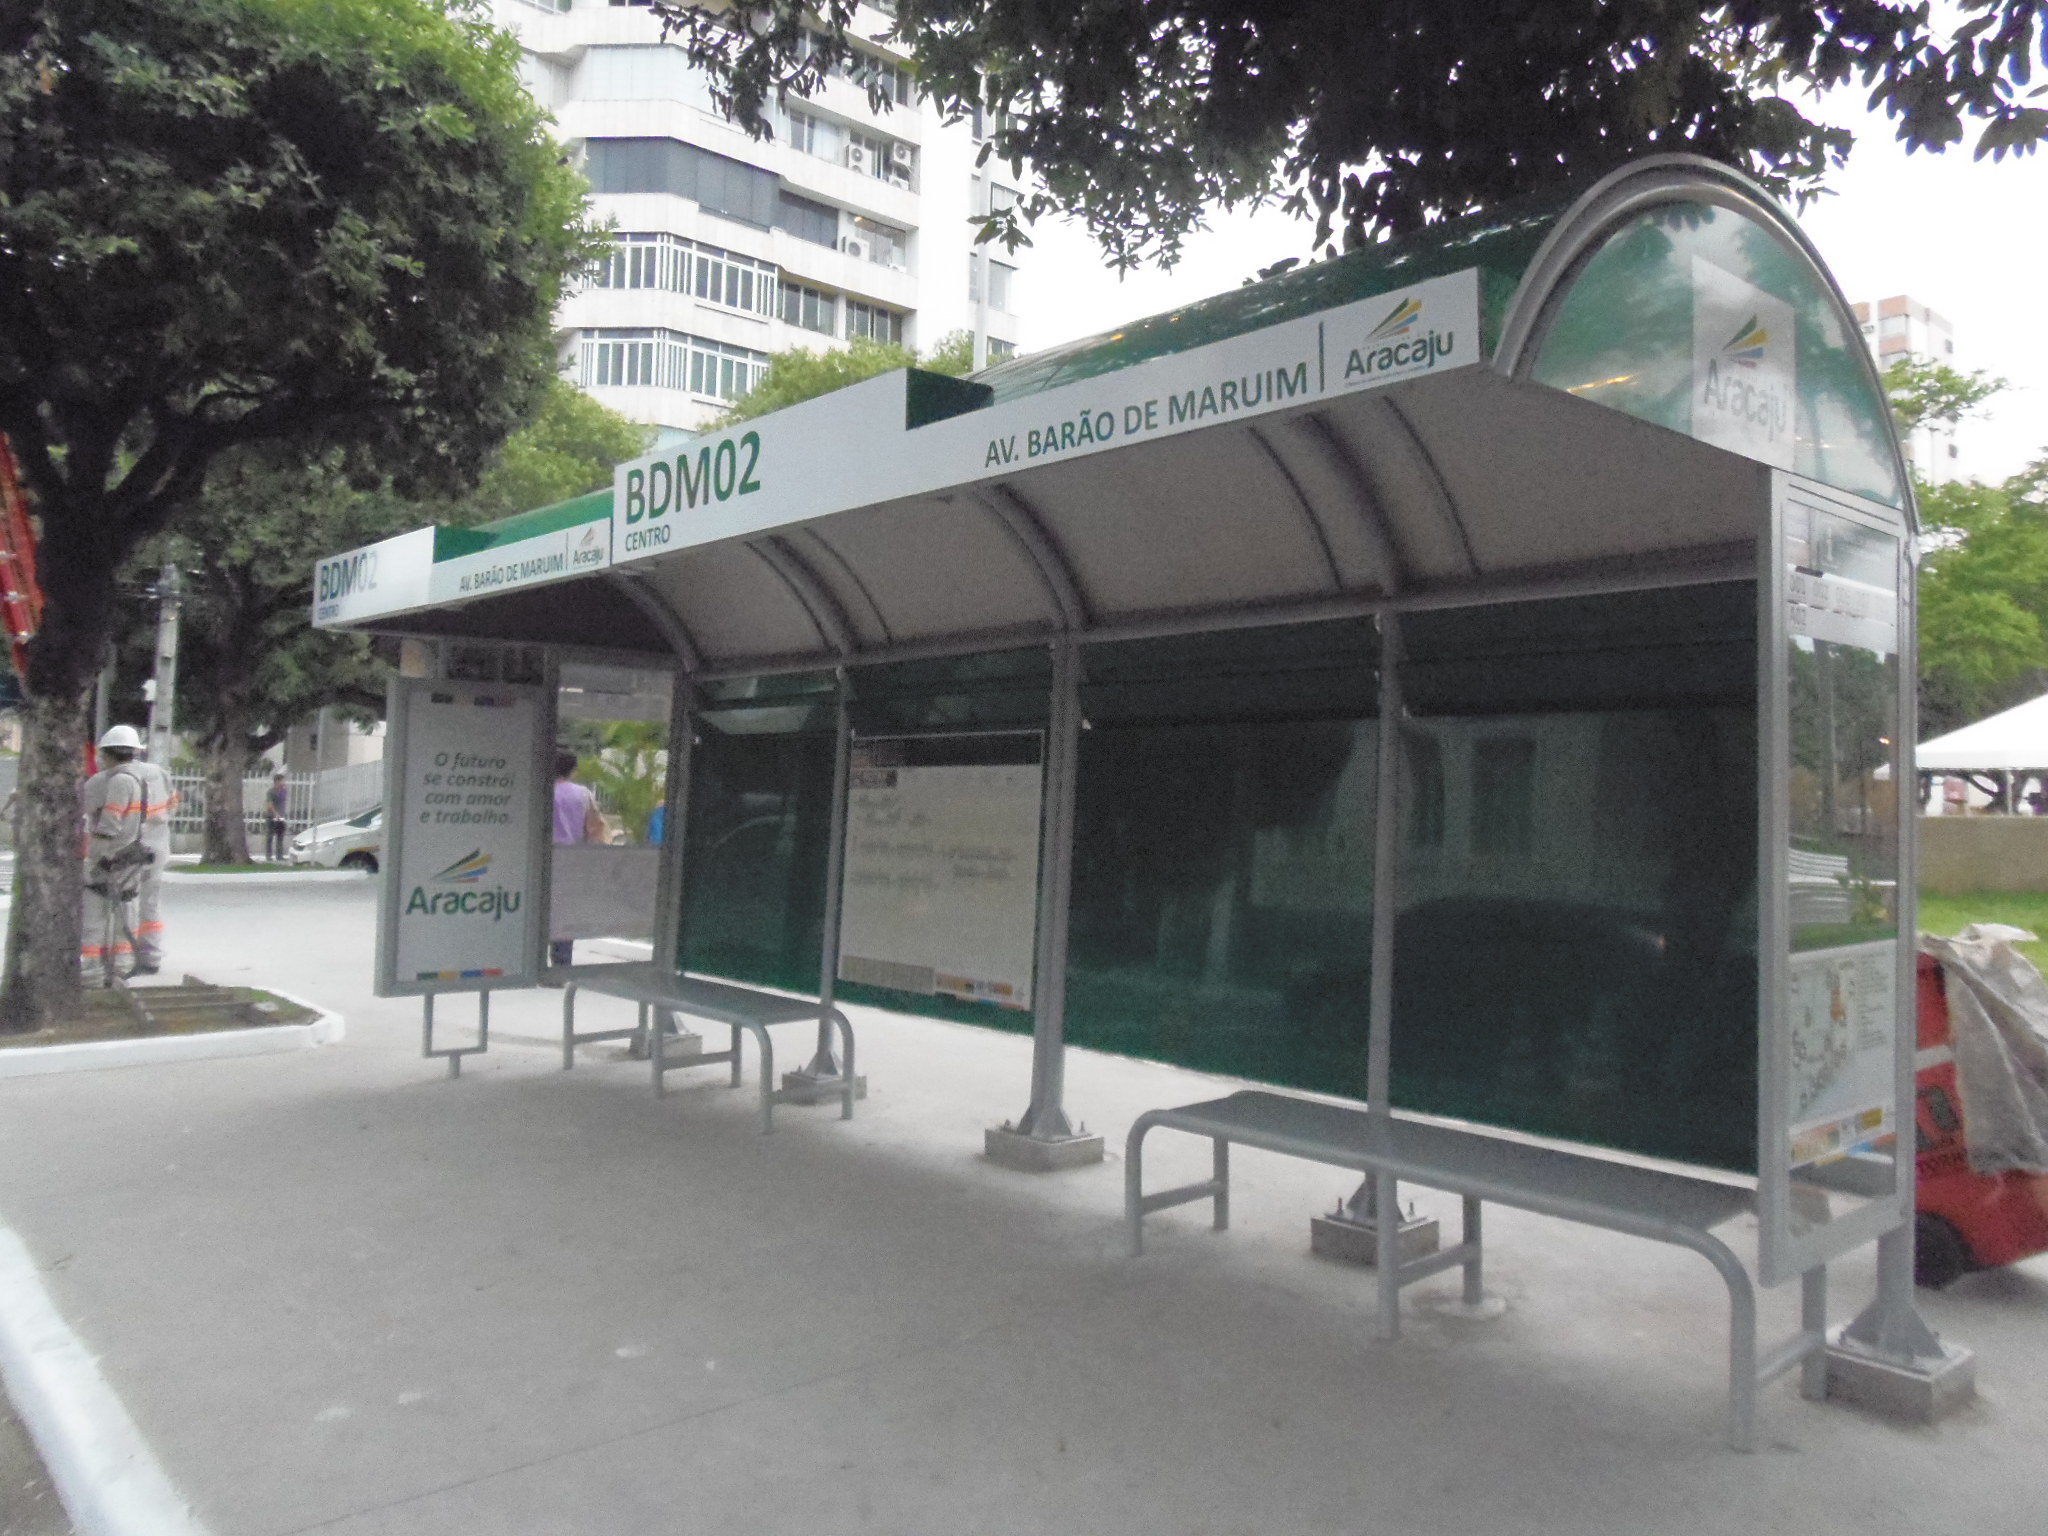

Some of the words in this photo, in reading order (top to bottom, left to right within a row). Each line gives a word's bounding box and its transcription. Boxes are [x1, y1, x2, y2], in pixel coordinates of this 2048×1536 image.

[1343, 329, 1454, 380] Aracaju
[984, 435, 1020, 468] AV.
[1027, 408, 1115, 459] BARÃO
[1123, 399, 1159, 436] DE
[1167, 361, 1308, 427] MARUIM
[1703, 356, 1790, 444] Aracaju
[625, 429, 762, 526] BDM02
[572, 546, 605, 565] Aracaju
[624, 524, 671, 552] CENTRO
[319, 549, 378, 602] BDM02
[458, 574, 472, 593] AV.
[474, 564, 504, 590] BARÃO
[506, 563, 518, 583] DE
[520, 552, 564, 580] MARUIM
[434, 751, 449, 767] O
[451, 752, 506, 771] futuro
[423, 773, 443, 786] se
[424, 792, 463, 805] com
[465, 793, 513, 806] amor
[420, 811, 430, 824] e
[405, 886, 521, 922] Aracaju
